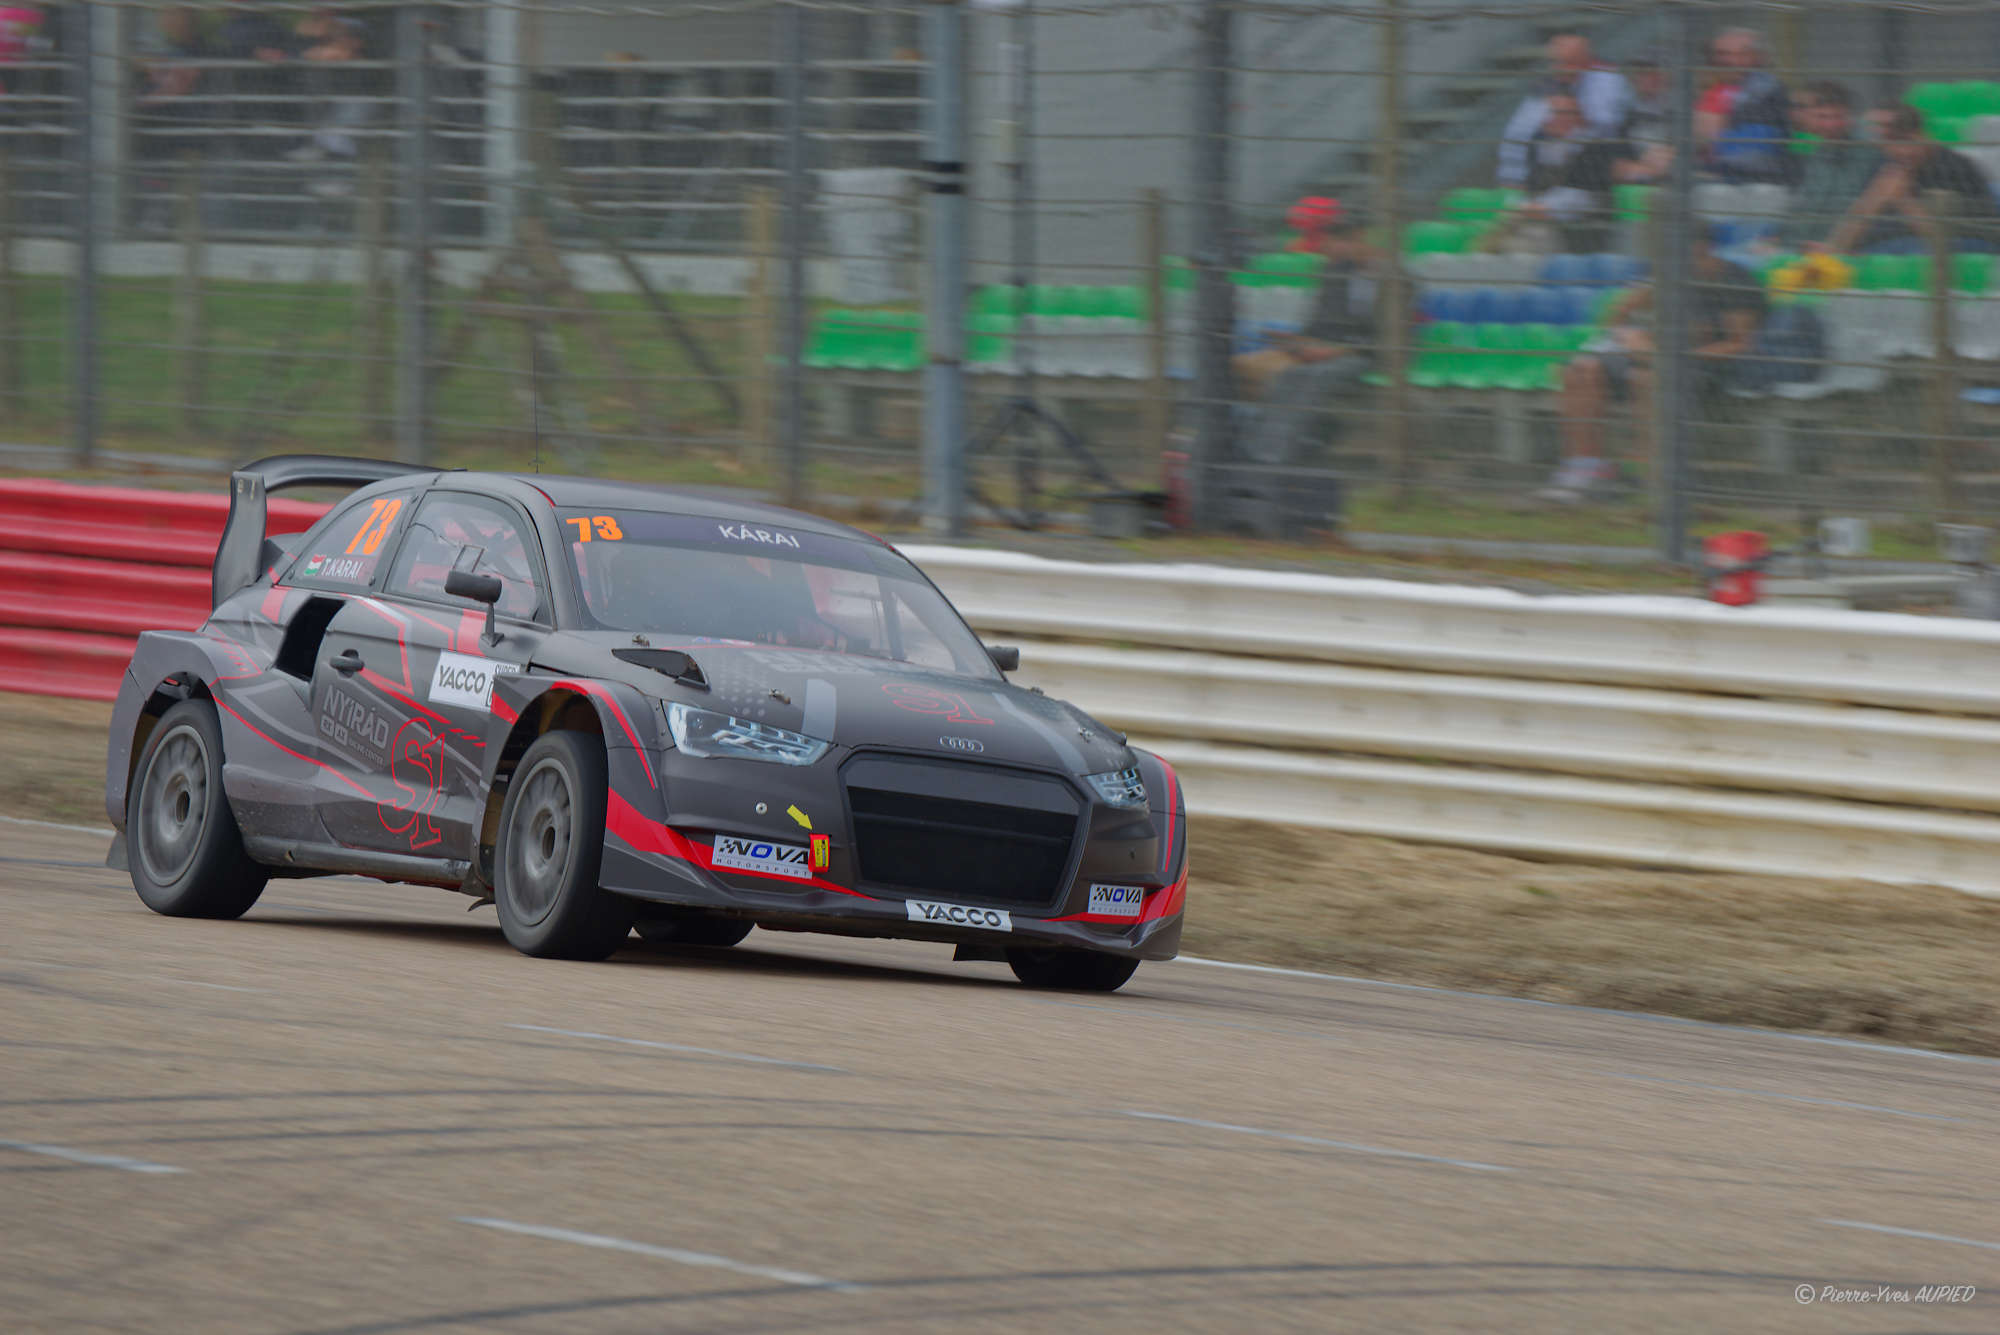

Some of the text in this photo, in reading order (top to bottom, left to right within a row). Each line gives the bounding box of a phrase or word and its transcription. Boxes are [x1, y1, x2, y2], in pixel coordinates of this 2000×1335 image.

[344, 498, 402, 555] 73
[566, 515, 623, 543] 73
[718, 524, 800, 548] KÁRAI
[438, 664, 486, 695] YACCO
[727, 839, 809, 865] NOVA
[716, 858, 809, 877] MOTORSPORT
[1096, 887, 1141, 904] NOVA
[916, 902, 1002, 927] YACCO
